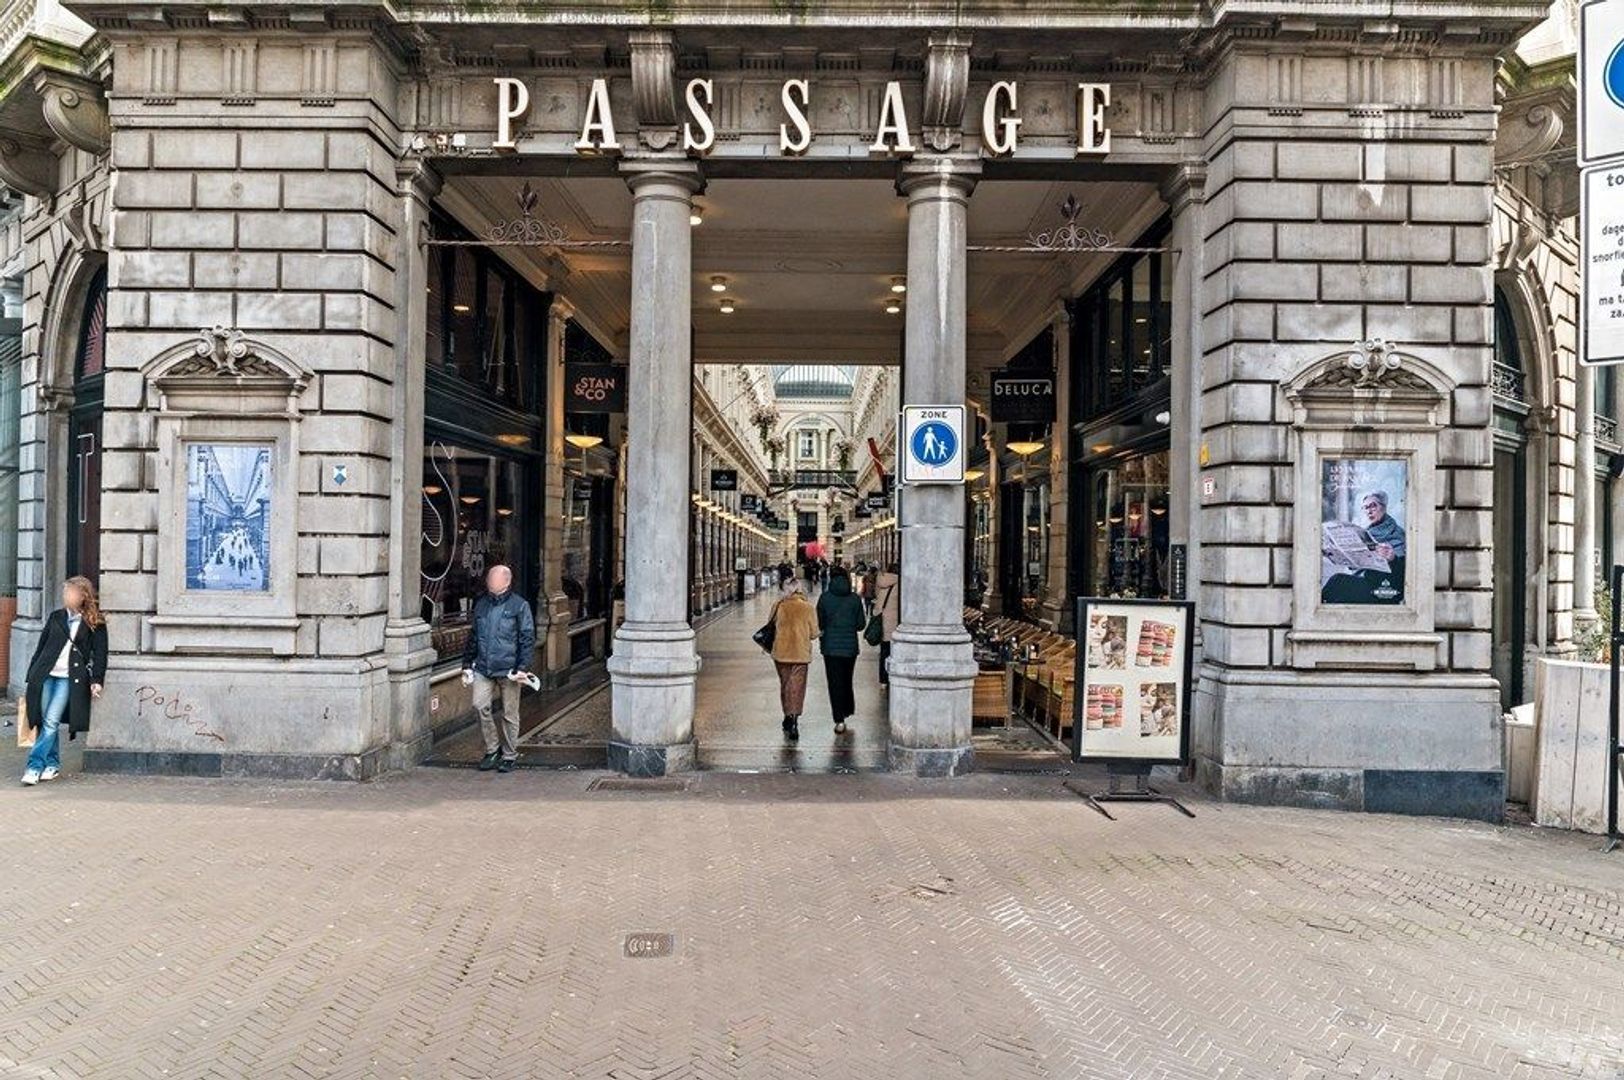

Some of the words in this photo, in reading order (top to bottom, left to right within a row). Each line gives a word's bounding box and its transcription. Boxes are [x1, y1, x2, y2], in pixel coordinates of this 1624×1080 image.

[492, 78, 1111, 154] PASSAGE
[580, 377, 616, 389] STAN
[994, 382, 1053, 395] DELUCA
[921, 411, 948, 419] ZONE
